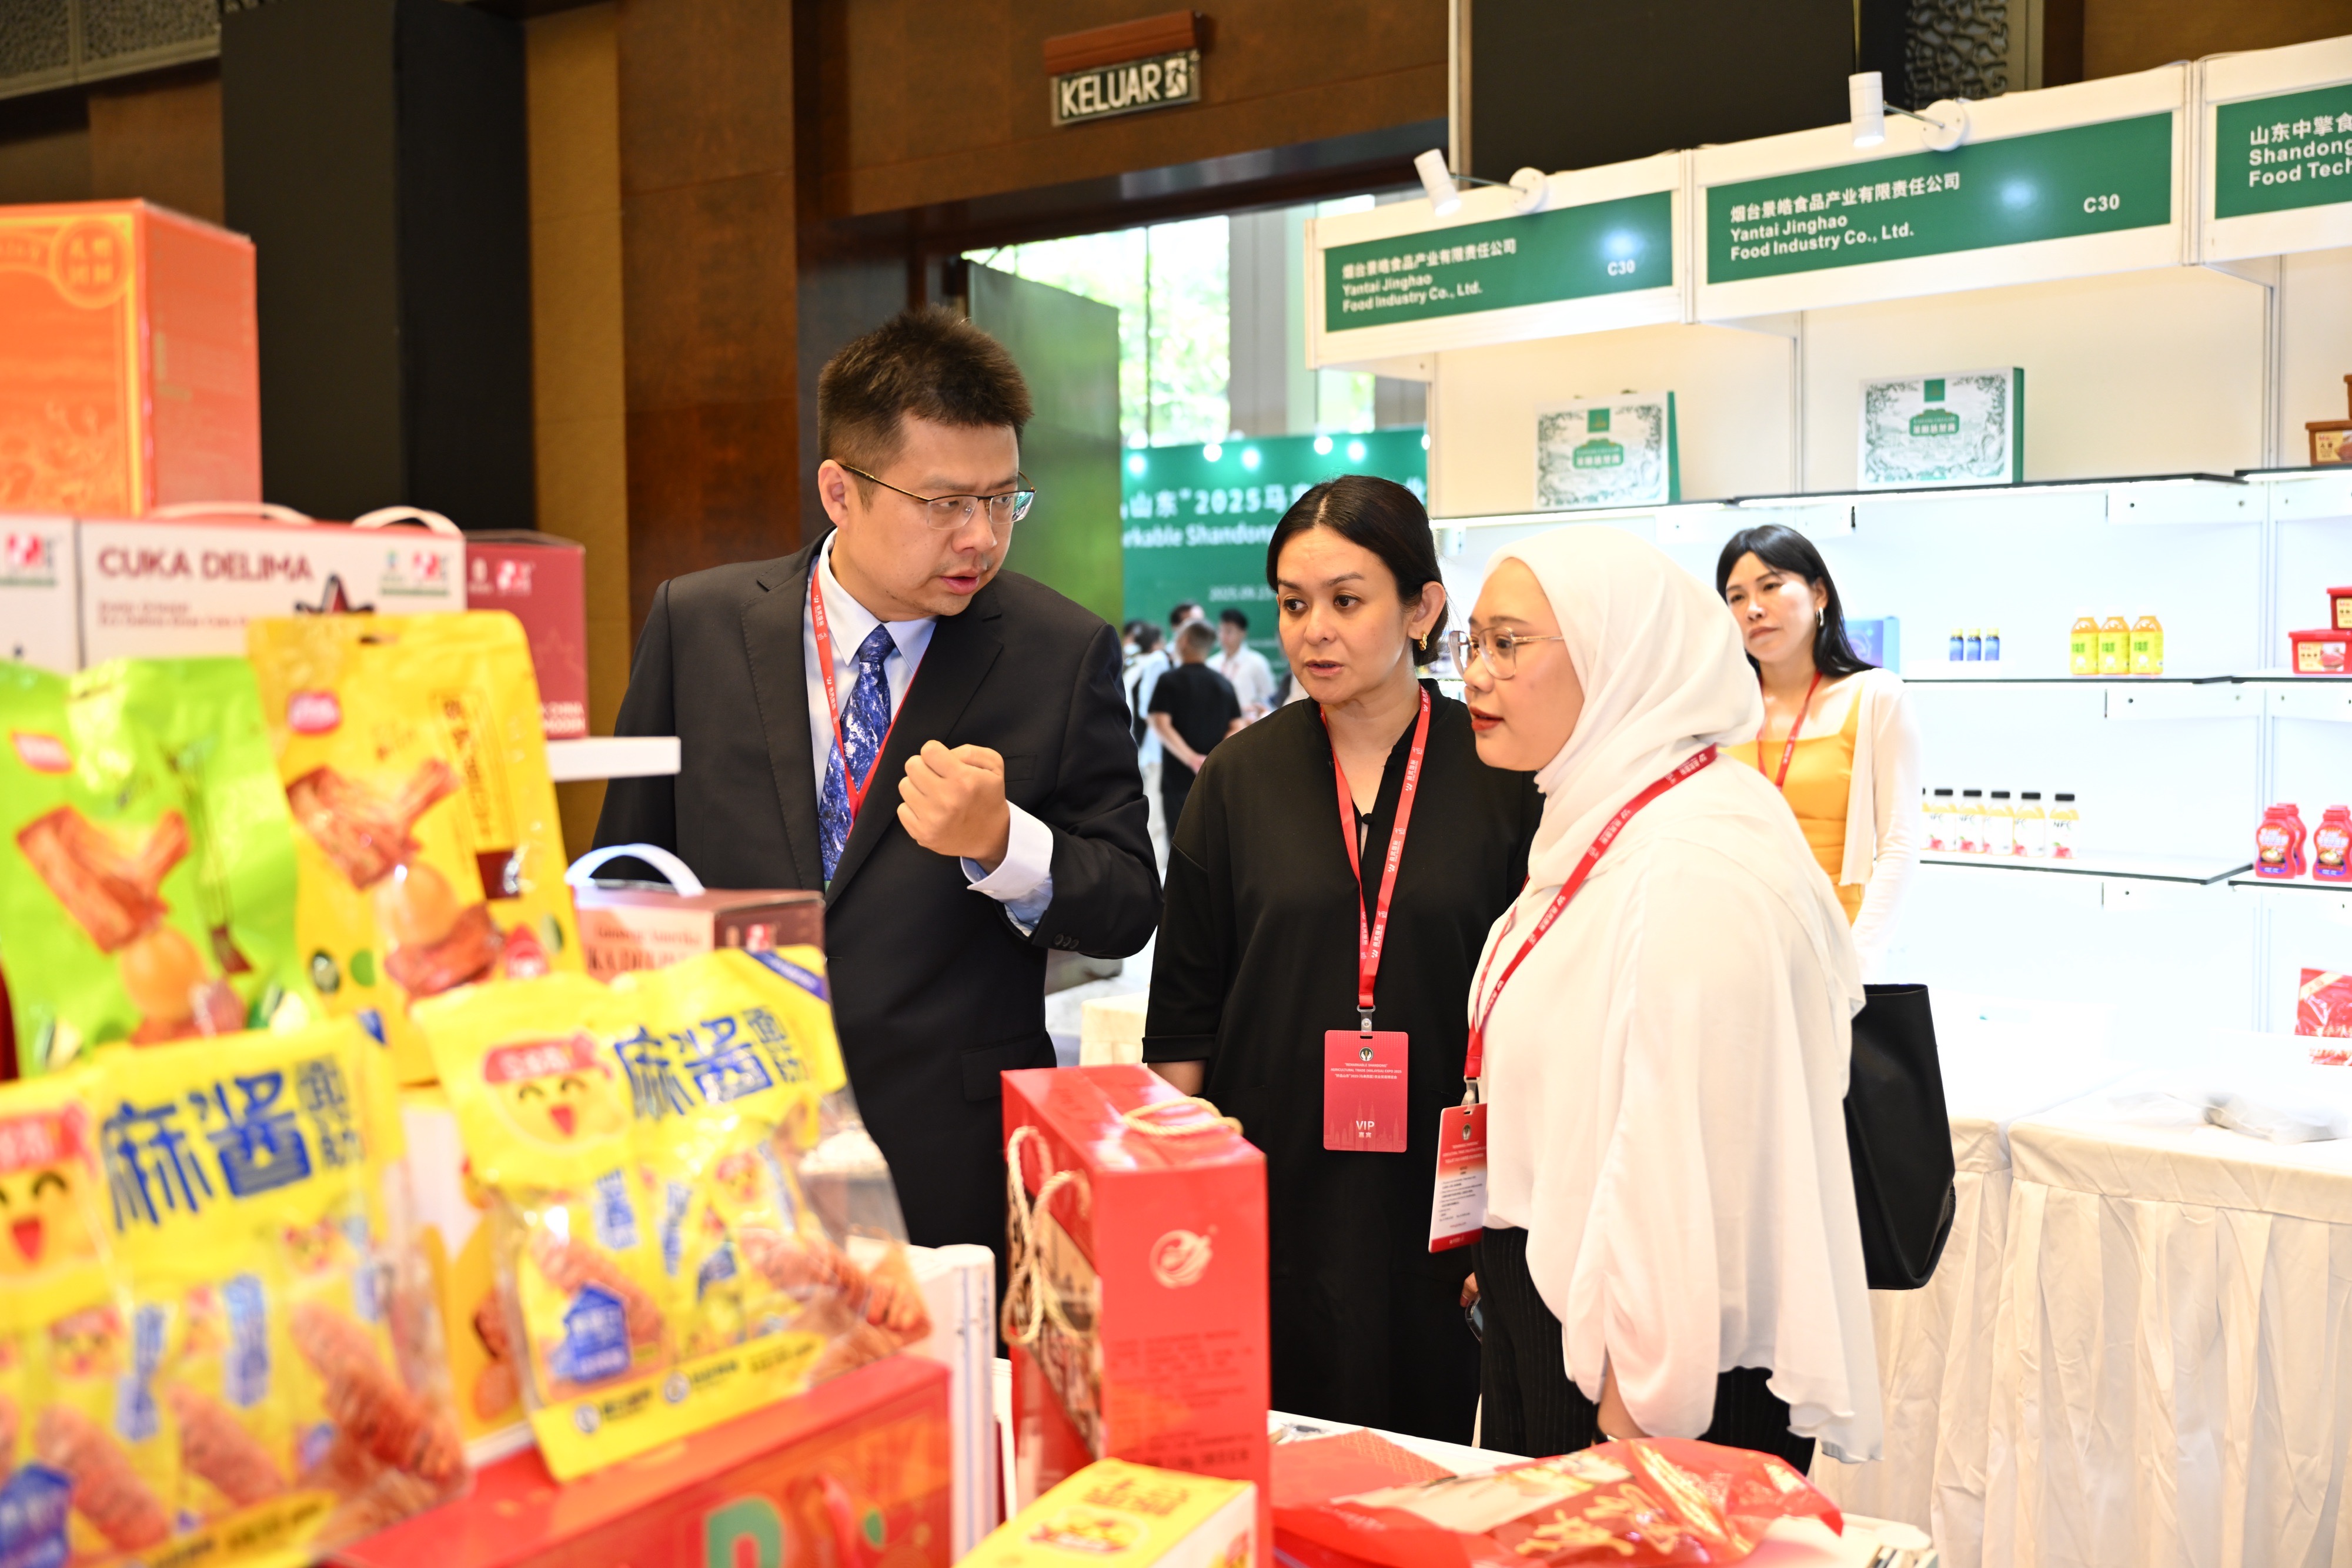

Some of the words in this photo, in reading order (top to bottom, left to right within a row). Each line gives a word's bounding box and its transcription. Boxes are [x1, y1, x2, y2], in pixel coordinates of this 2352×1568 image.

[1061, 63, 1162, 117] KELUAR
[2249, 138, 2352, 166] Shandong
[2249, 164, 2301, 188] Food
[1730, 172, 1960, 223] 烟台景皓食品产业有限责任公司
[2084, 194, 2120, 213] C30
[1730, 222, 1779, 242] Yantai
[1783, 215, 1847, 235] Jinghao
[1731, 243, 1770, 260] Food
[1773, 234, 1840, 255] Industry
[1845, 229, 1877, 245] Co.,
[1882, 222, 1914, 240] Ltd.
[1608, 259, 1635, 276] C30
[1343, 280, 1380, 296] Yantai
[1382, 275, 1433, 291] Jinghao
[1343, 297, 1373, 313] Food
[1375, 290, 1427, 307] Industry
[1429, 287, 1455, 300] Co.,
[1457, 280, 1483, 296] Ltd.
[99, 547, 191, 577] CUKA
[202, 550, 313, 581] DELIMA
[614, 1016, 773, 1120] 麻酱
[1355, 1120, 1375, 1130] VIP
[101, 1070, 312, 1233] 麻酱
